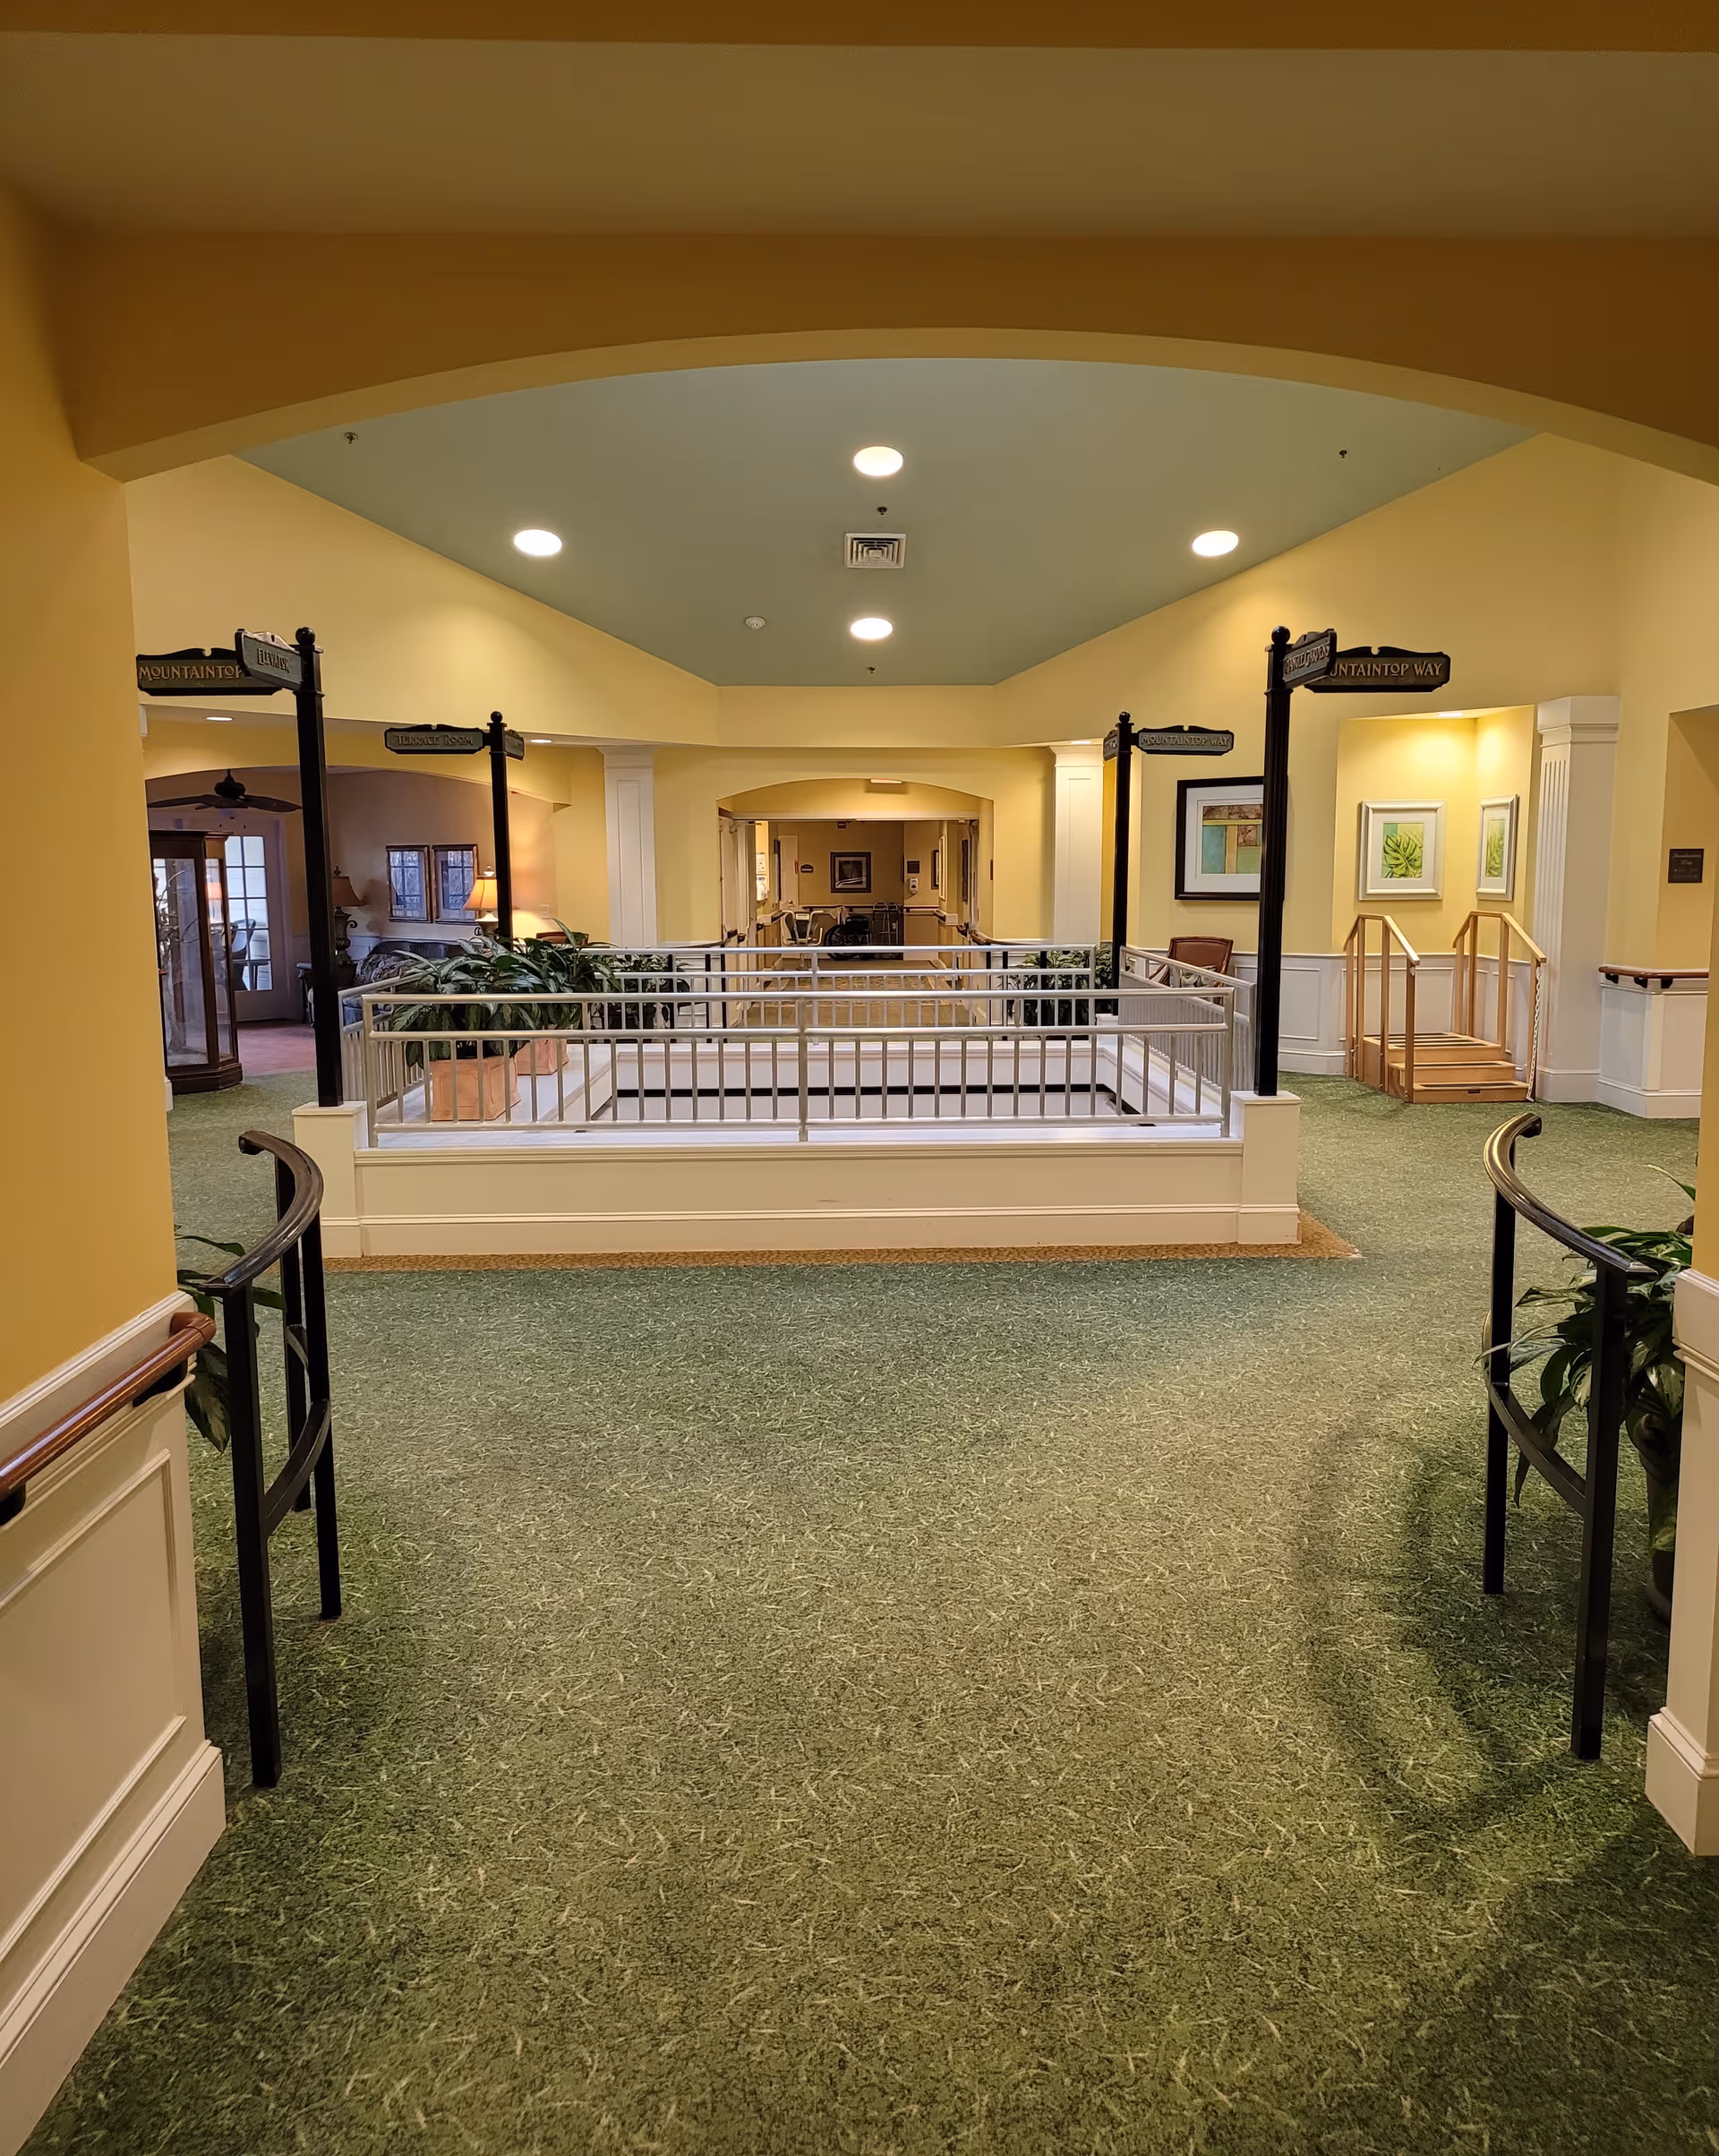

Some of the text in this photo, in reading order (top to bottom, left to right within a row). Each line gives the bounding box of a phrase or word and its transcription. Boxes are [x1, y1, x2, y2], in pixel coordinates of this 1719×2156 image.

[256, 647, 290, 673] ELEVATOR
[1414, 660, 1442, 676] WAY
[397, 734, 473, 746] TERRACE ROOM
[1142, 734, 1229, 747] MOUNTAINTOP WAY
